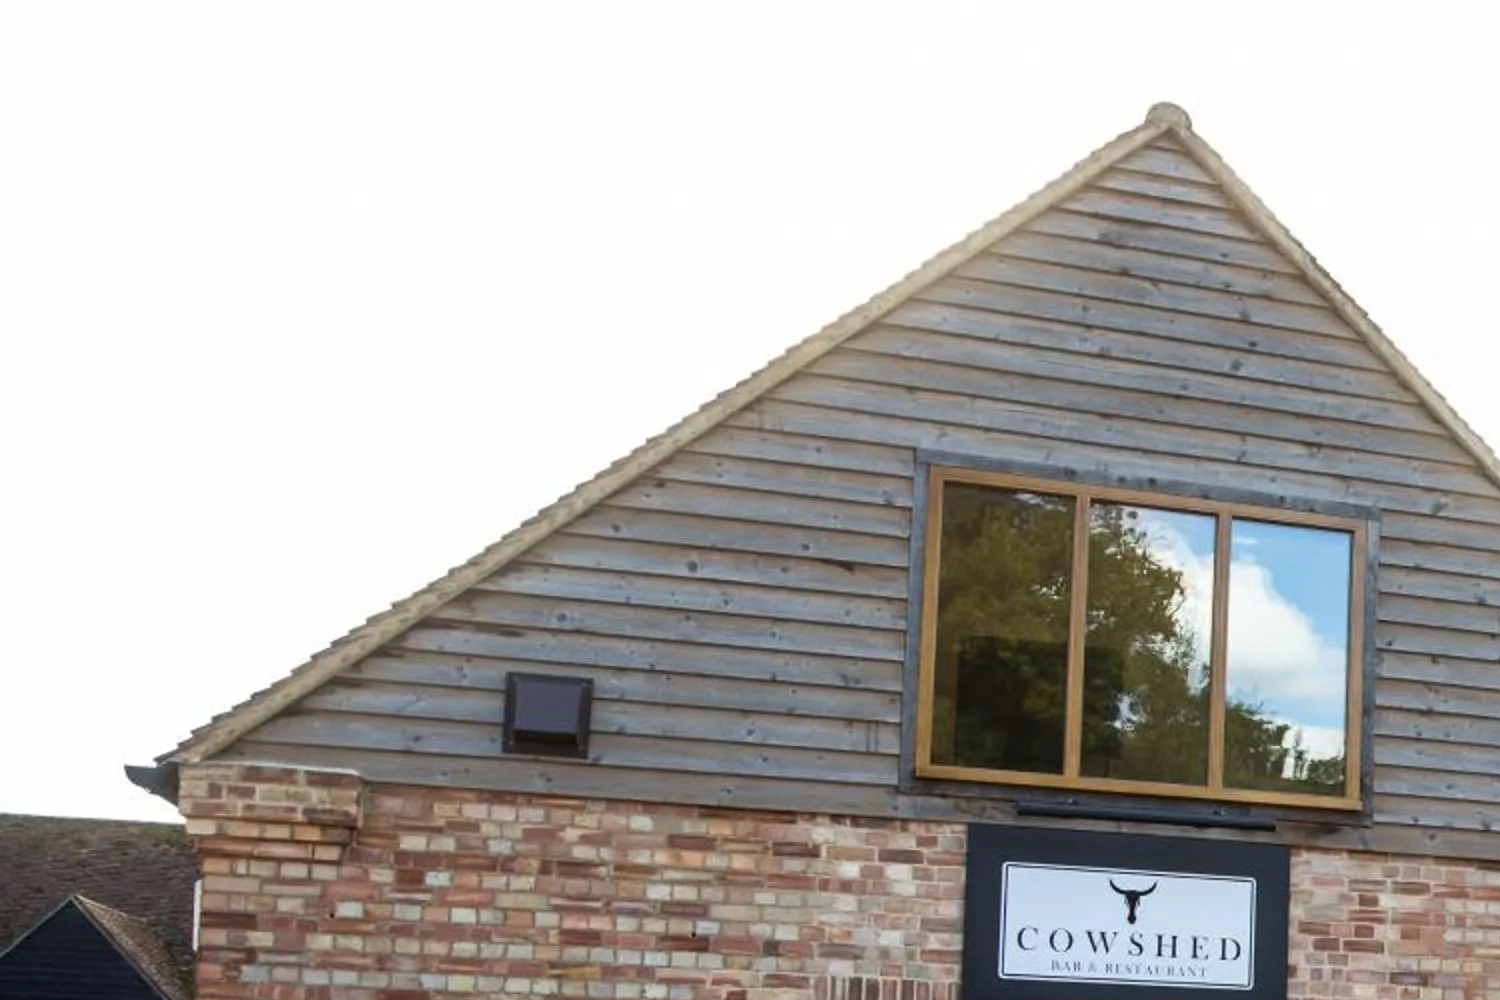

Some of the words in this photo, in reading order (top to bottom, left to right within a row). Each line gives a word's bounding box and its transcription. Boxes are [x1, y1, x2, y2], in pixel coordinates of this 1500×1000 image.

[1016, 926, 1242, 962] COWSHED
[1051, 959, 1081, 973] BAR
[1105, 962, 1206, 977] RESTAURANT
